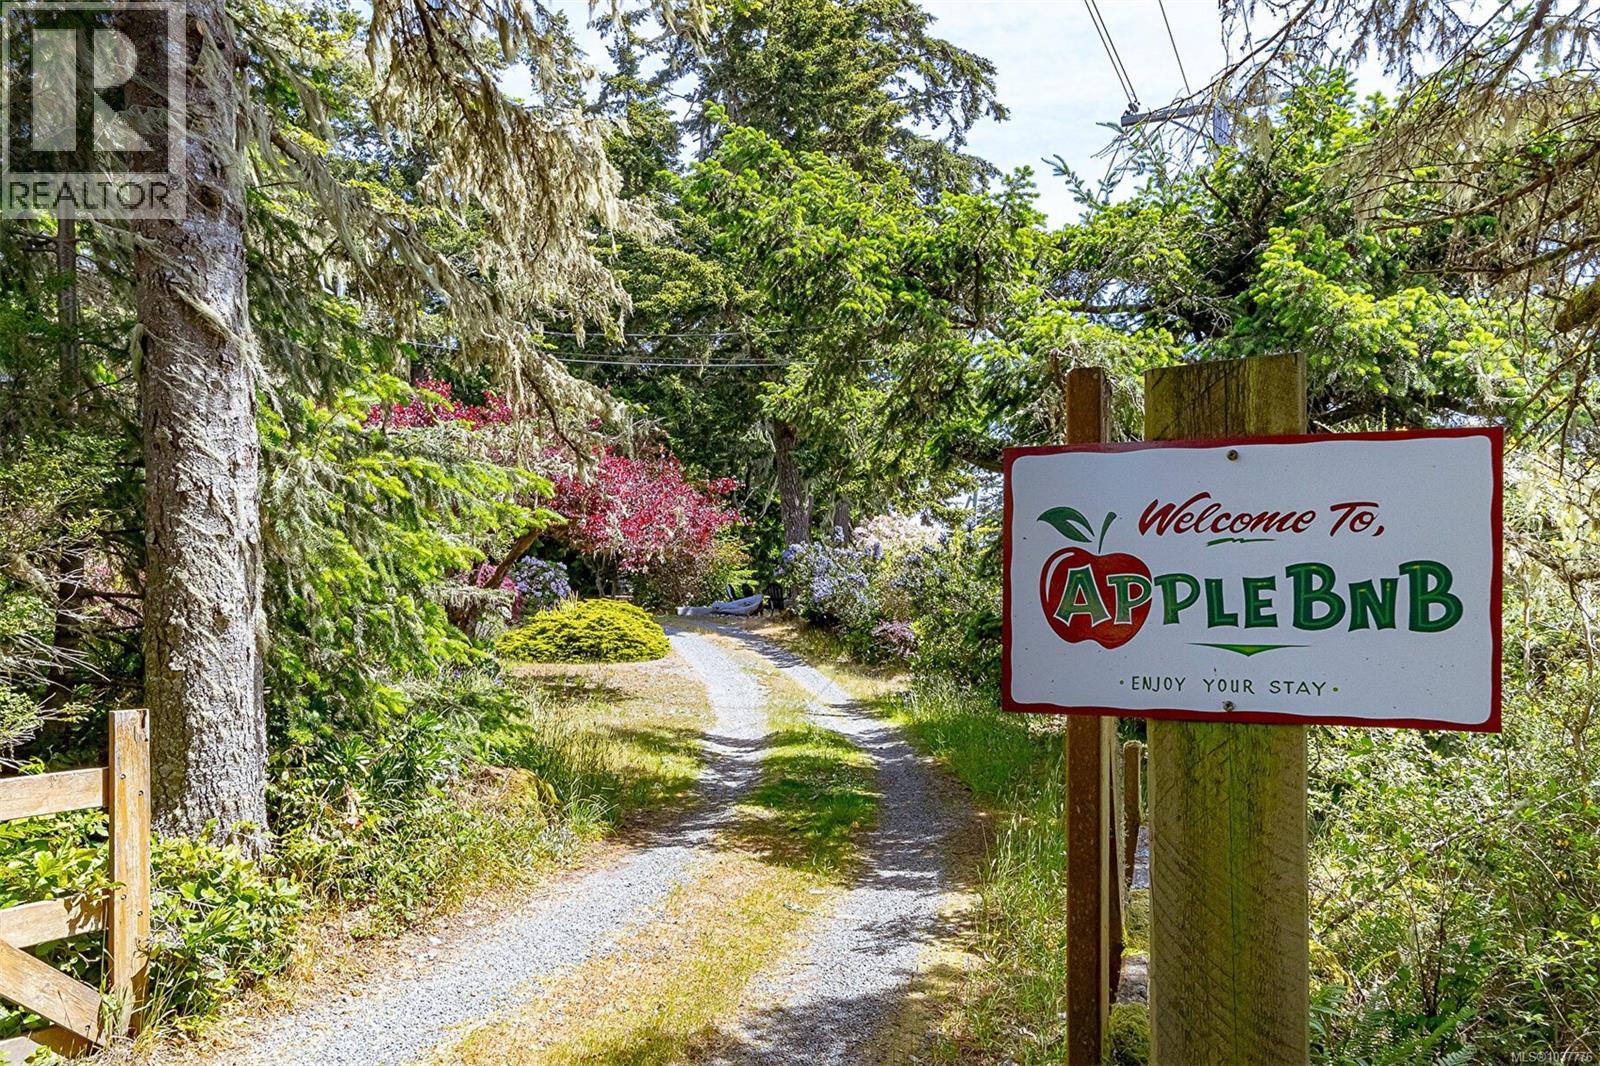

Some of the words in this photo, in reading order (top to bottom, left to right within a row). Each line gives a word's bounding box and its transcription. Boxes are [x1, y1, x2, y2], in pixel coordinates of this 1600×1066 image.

[1138, 491, 1317, 537] Welcome
[1330, 501, 1385, 537] To,
[1131, 676, 1186, 693] ENJOY
[1202, 678, 1255, 695] YOUR
[1269, 680, 1326, 696] STAY
